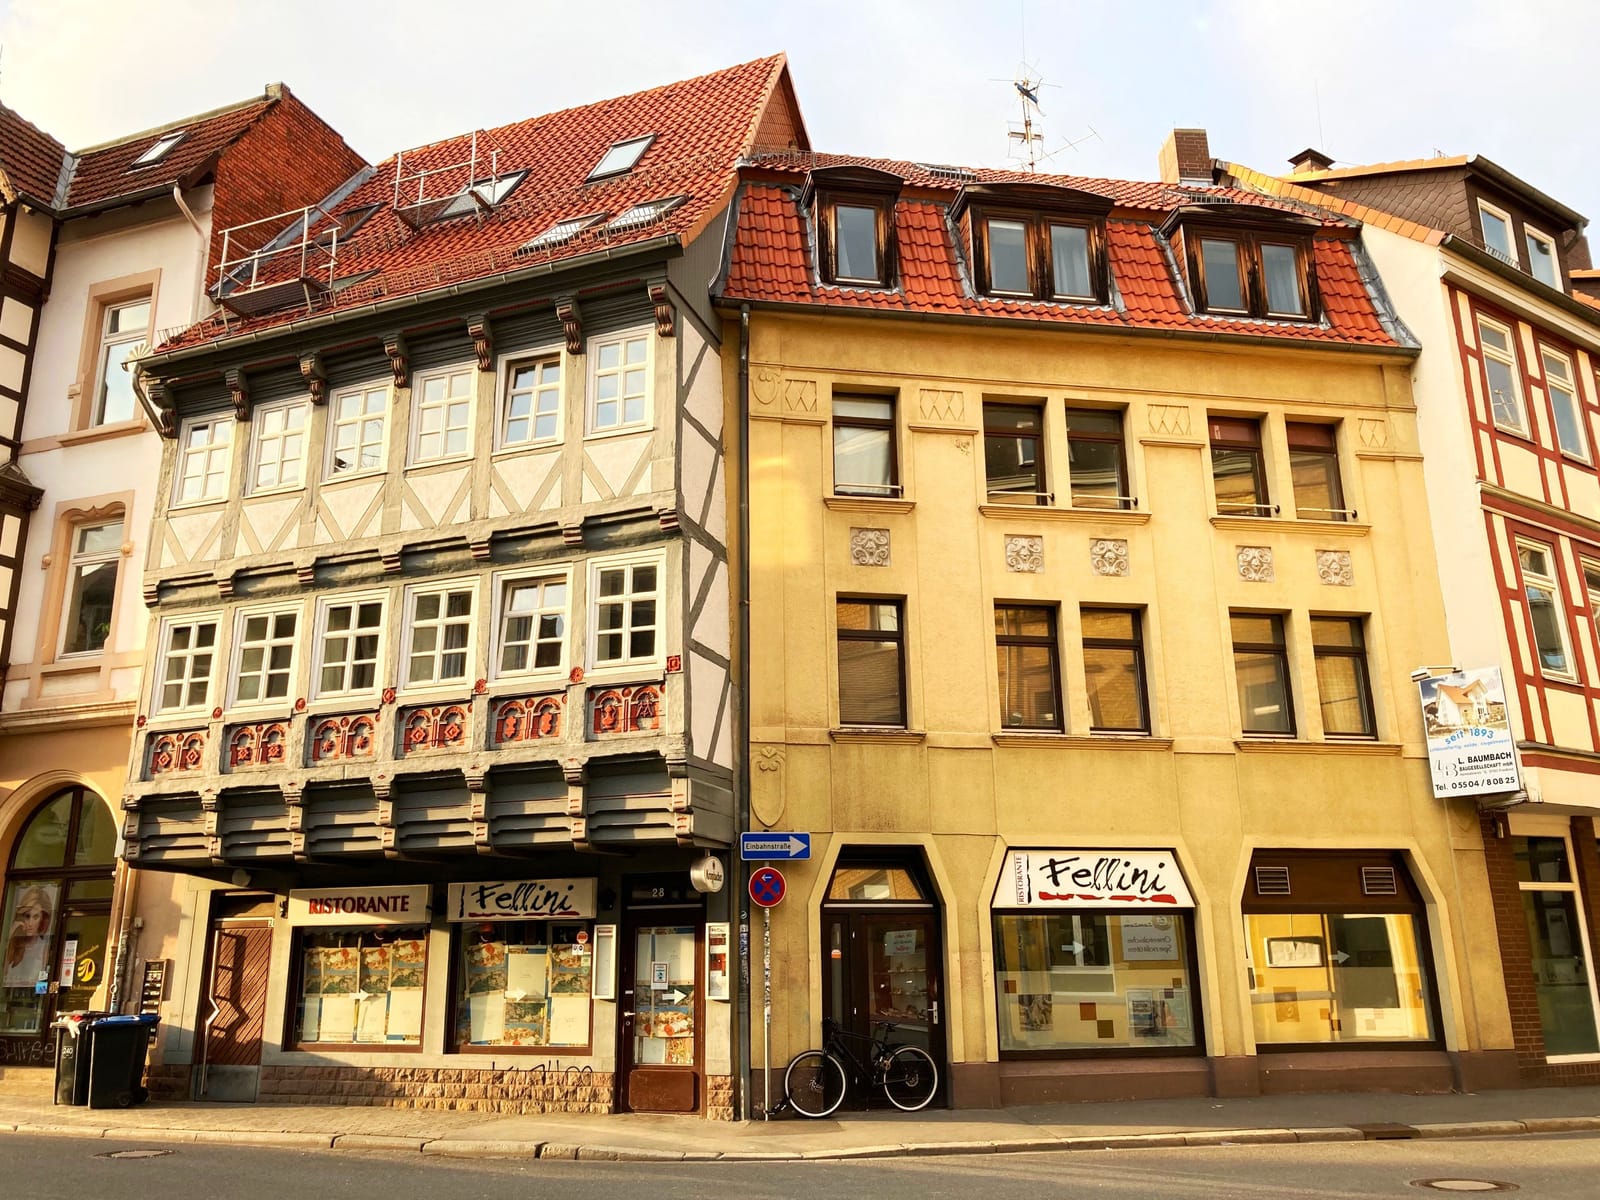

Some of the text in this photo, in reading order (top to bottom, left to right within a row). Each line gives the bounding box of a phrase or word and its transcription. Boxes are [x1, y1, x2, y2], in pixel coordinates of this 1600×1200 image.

[1445, 728, 1494, 744] seit 1893
[1458, 752, 1512, 765] L. BAUMBACH
[1459, 762, 1502, 772] BAUGESELLSCHAFT
[1435, 783, 1449, 791] Tel.
[1016, 856, 1025, 902] RISTORANTE
[1039, 857, 1167, 894] Fellini
[471, 883, 575, 914] Fellini
[652, 887, 665, 898] 28
[309, 895, 410, 915] RISTORANTE
